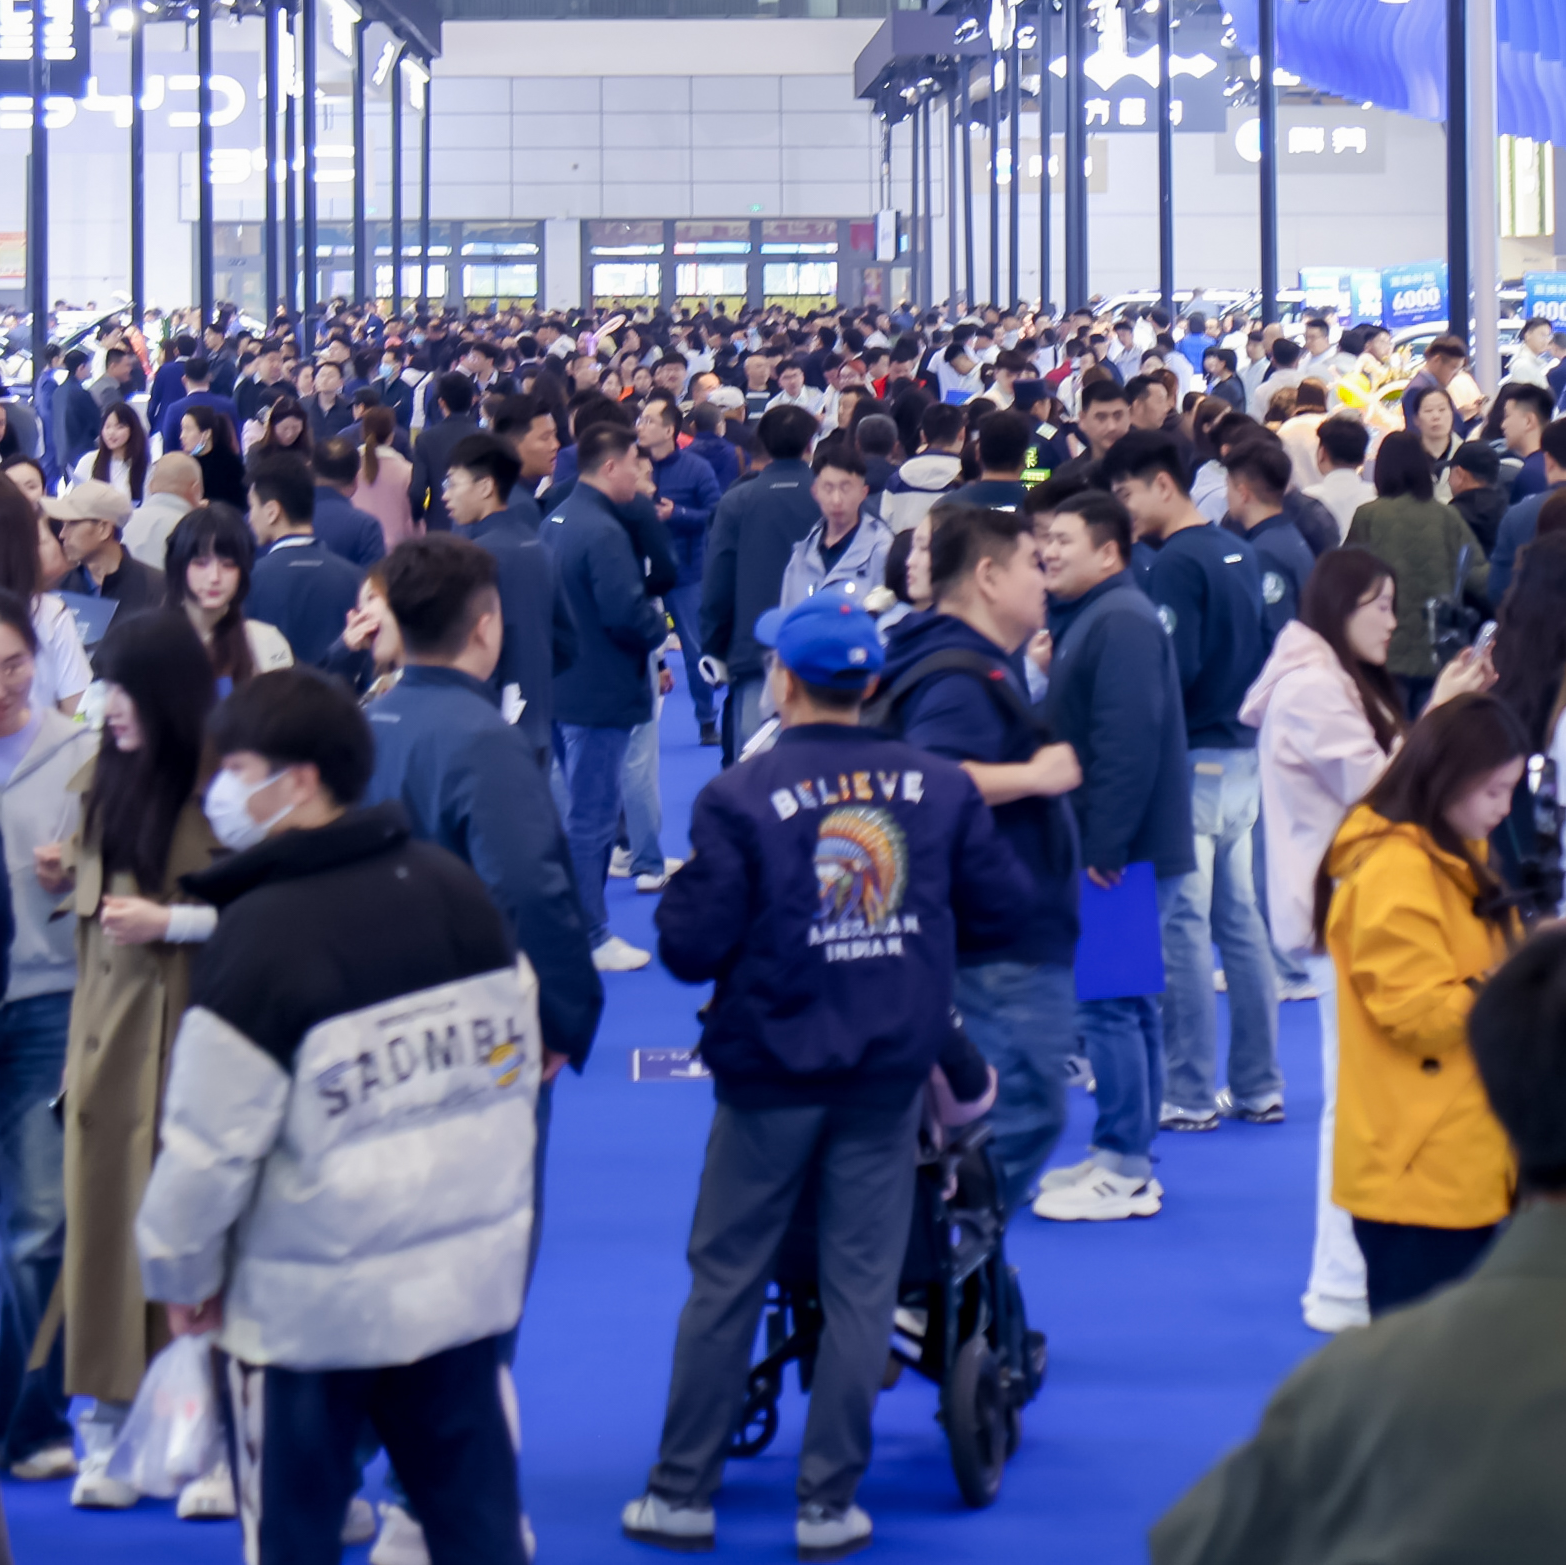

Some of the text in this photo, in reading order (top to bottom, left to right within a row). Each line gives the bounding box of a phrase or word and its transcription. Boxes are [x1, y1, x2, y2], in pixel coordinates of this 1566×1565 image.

[1392, 286, 1441, 311] 6000
[771, 771, 924, 821] BELIEVE
[826, 937, 904, 962] INDIAN
